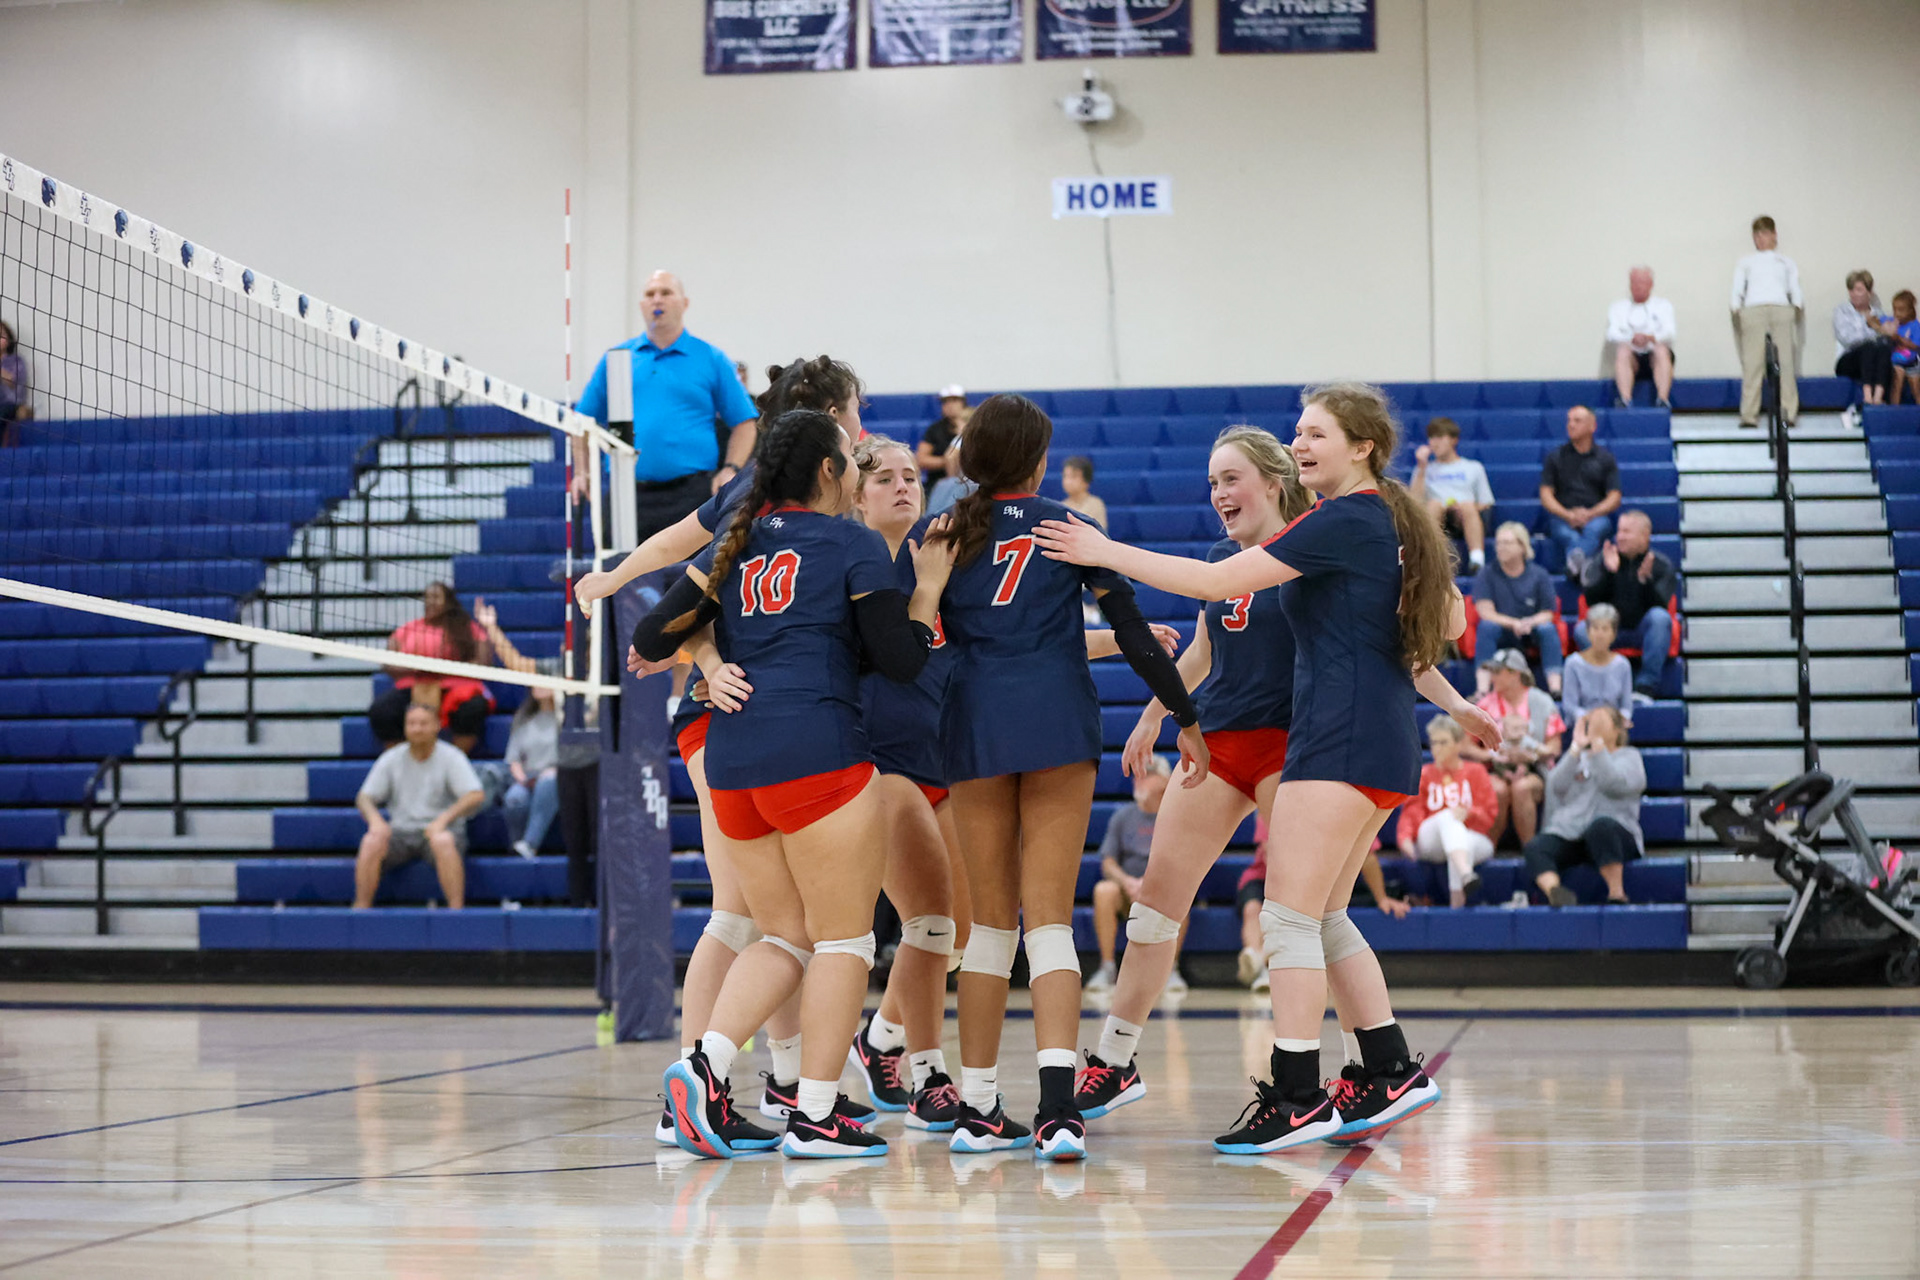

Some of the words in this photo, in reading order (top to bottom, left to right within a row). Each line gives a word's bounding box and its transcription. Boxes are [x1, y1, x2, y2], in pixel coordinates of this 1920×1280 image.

[1067, 182, 1157, 209] HOME
[739, 548, 802, 617] 10
[991, 534, 1037, 607] 7
[1221, 592, 1255, 632] 3
[1426, 778, 1474, 812] USA
